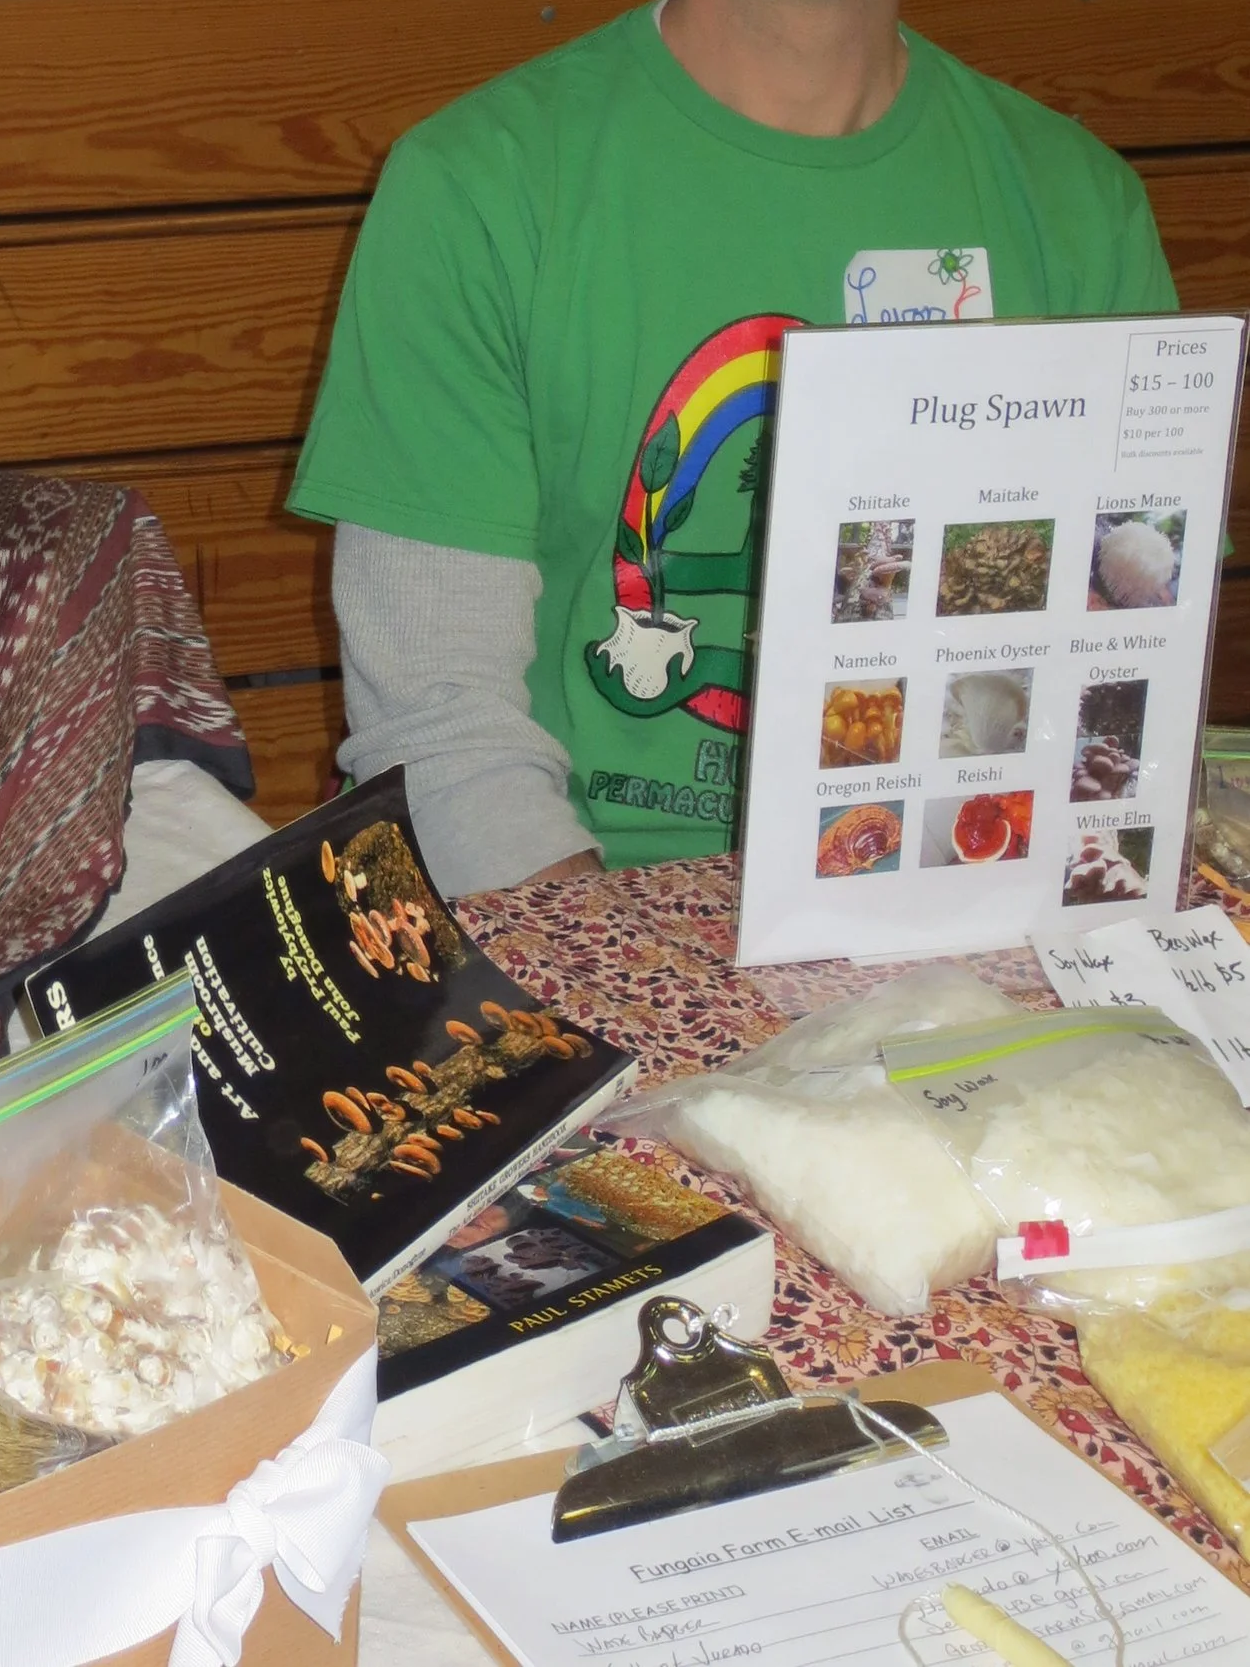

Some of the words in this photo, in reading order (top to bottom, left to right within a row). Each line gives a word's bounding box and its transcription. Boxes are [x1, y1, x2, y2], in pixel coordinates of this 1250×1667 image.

[1156, 339, 1208, 356] Prices
[1129, 374, 1162, 392] $15
[1182, 372, 1214, 390] 100
[910, 397, 978, 431] Plug
[986, 394, 1087, 428] Spawn
[1126, 406, 1146, 419] Buy
[1148, 405, 1168, 416] 300
[1170, 407, 1182, 415] or
[1183, 405, 1210, 414] more
[1123, 428, 1143, 440] $10
[1144, 428, 1161, 441] per
[1165, 427, 1184, 438] 100
[848, 494, 911, 512] Shiitake
[978, 487, 1039, 504] Maitake
[1096, 494, 1137, 510] Lions
[1139, 493, 1182, 509] Mane
[935, 646, 997, 663] Phoenix
[1000, 643, 1051, 660] Oyster
[1069, 638, 1103, 654] Blue
[1106, 638, 1119, 651] &
[1122, 635, 1167, 649] White
[833, 652, 898, 670] Nameko
[1088, 665, 1139, 681] Oyster
[816, 779, 872, 798] Oregon
[876, 774, 922, 790] Reishi
[956, 767, 1004, 784] Reishi
[588, 769, 735, 824] PERMACU
[1076, 813, 1122, 830] White
[1123, 811, 1152, 827] Elm
[263, 867, 325, 1002] Przybylowicz
[278, 875, 326, 977] Donoghue
[279, 955, 297, 982] by
[196, 935, 276, 1072] Cultivation
[322, 976, 361, 1023] John
[184, 950, 261, 1078] Mushroom
[322, 1001, 362, 1044] Paul
[220, 1082, 260, 1120] Art
[922, 1088, 969, 1113] Soy
[955, 1073, 999, 1094] Wax
[508, 1306, 568, 1334] PAUL
[567, 1263, 664, 1309] STAMETS
[628, 1550, 722, 1582] Fungaia
[722, 1535, 786, 1562] Farm
[786, 1516, 863, 1545] E-mail
[869, 1502, 917, 1524] List
[919, 1528, 978, 1550] EMAIL
[550, 1614, 607, 1634] NAME
[608, 1598, 681, 1626] (PLEASE
[682, 1584, 746, 1609] PRINT)
